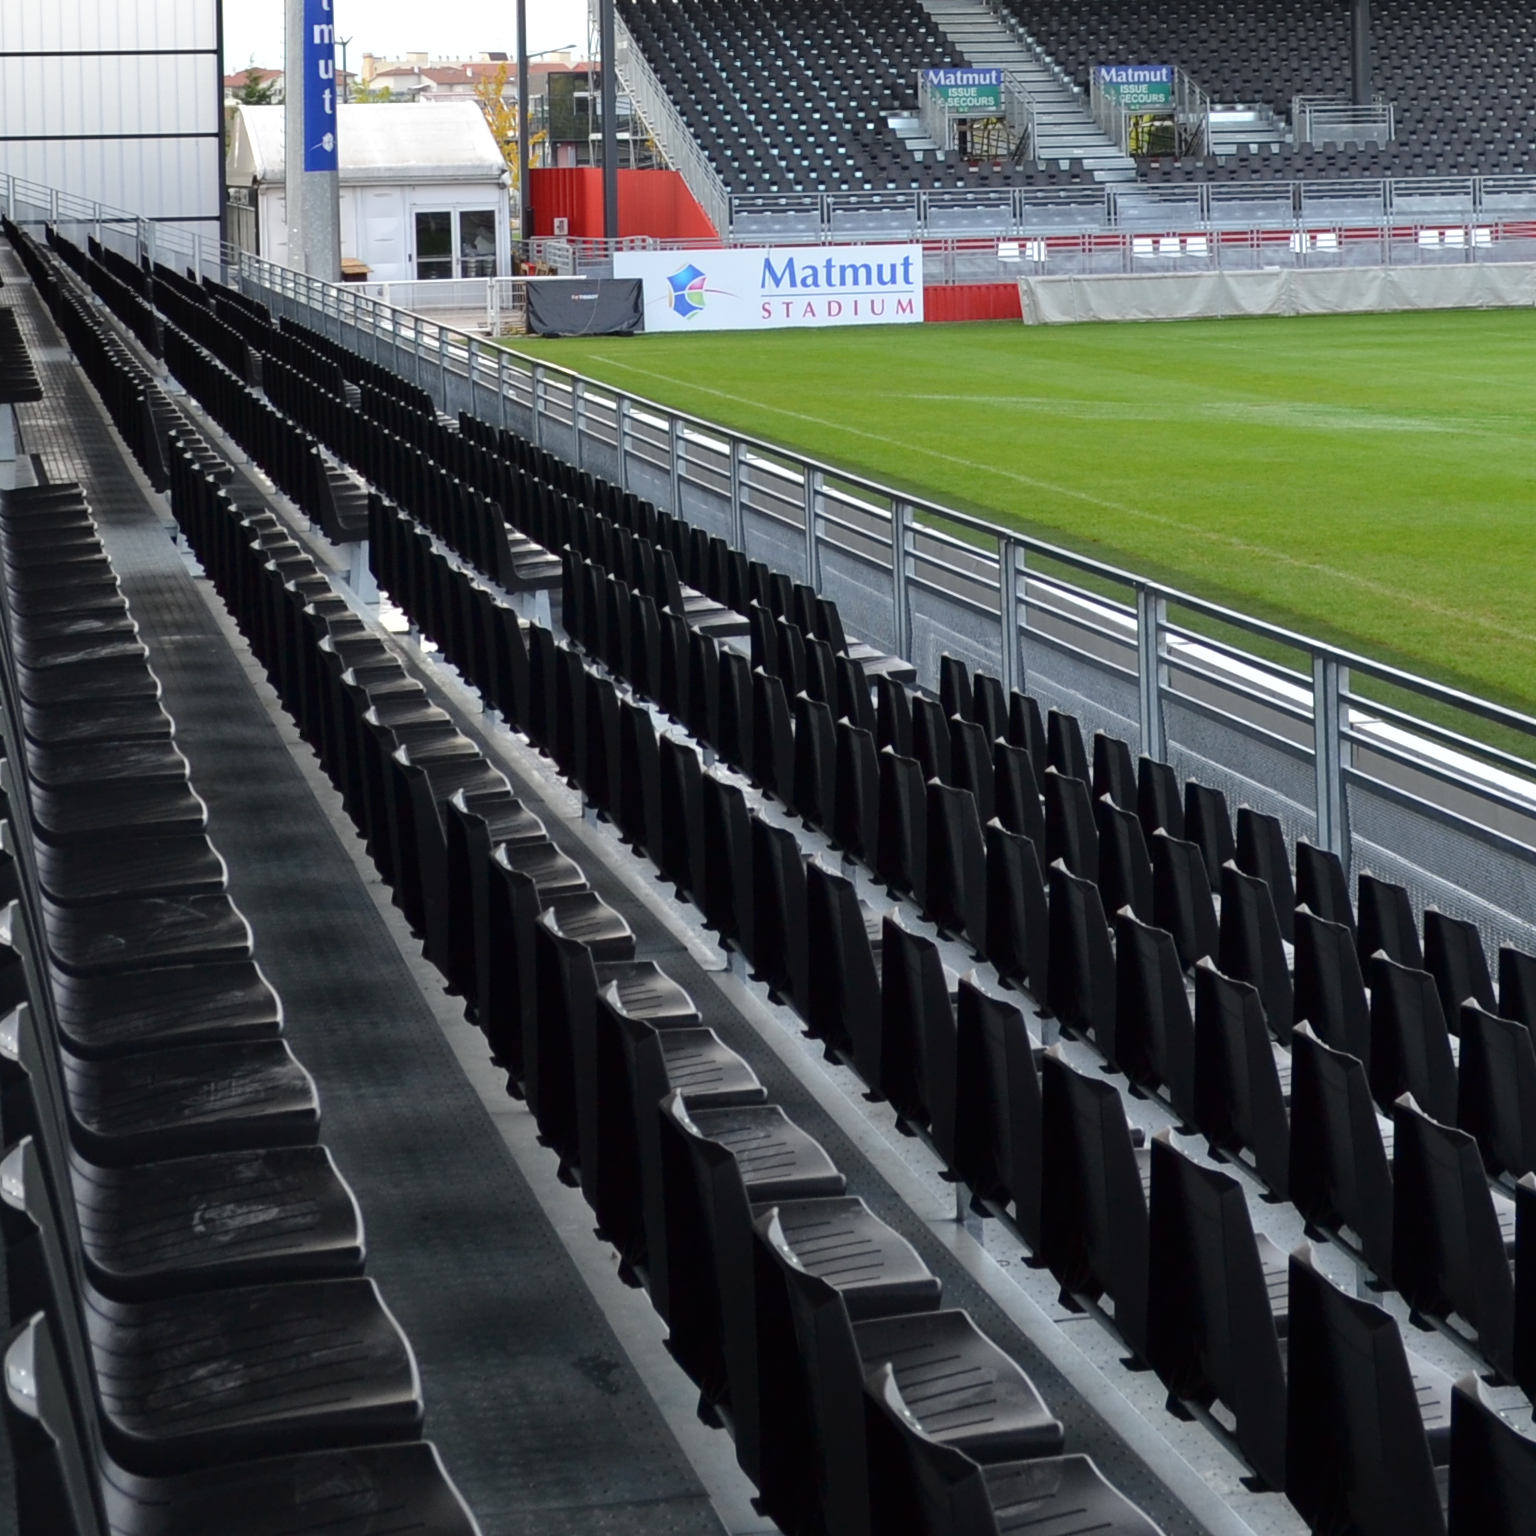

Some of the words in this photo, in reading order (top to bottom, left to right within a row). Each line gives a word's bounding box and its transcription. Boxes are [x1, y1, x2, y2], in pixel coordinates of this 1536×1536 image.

[928, 69, 998, 86] Matmut
[1100, 67, 1169, 83] Matmut
[948, 87, 978, 97] ISSUE
[1119, 84, 1149, 94] ISSUE
[760, 255, 914, 289] Matmut
[761, 298, 915, 319] STADIUM
